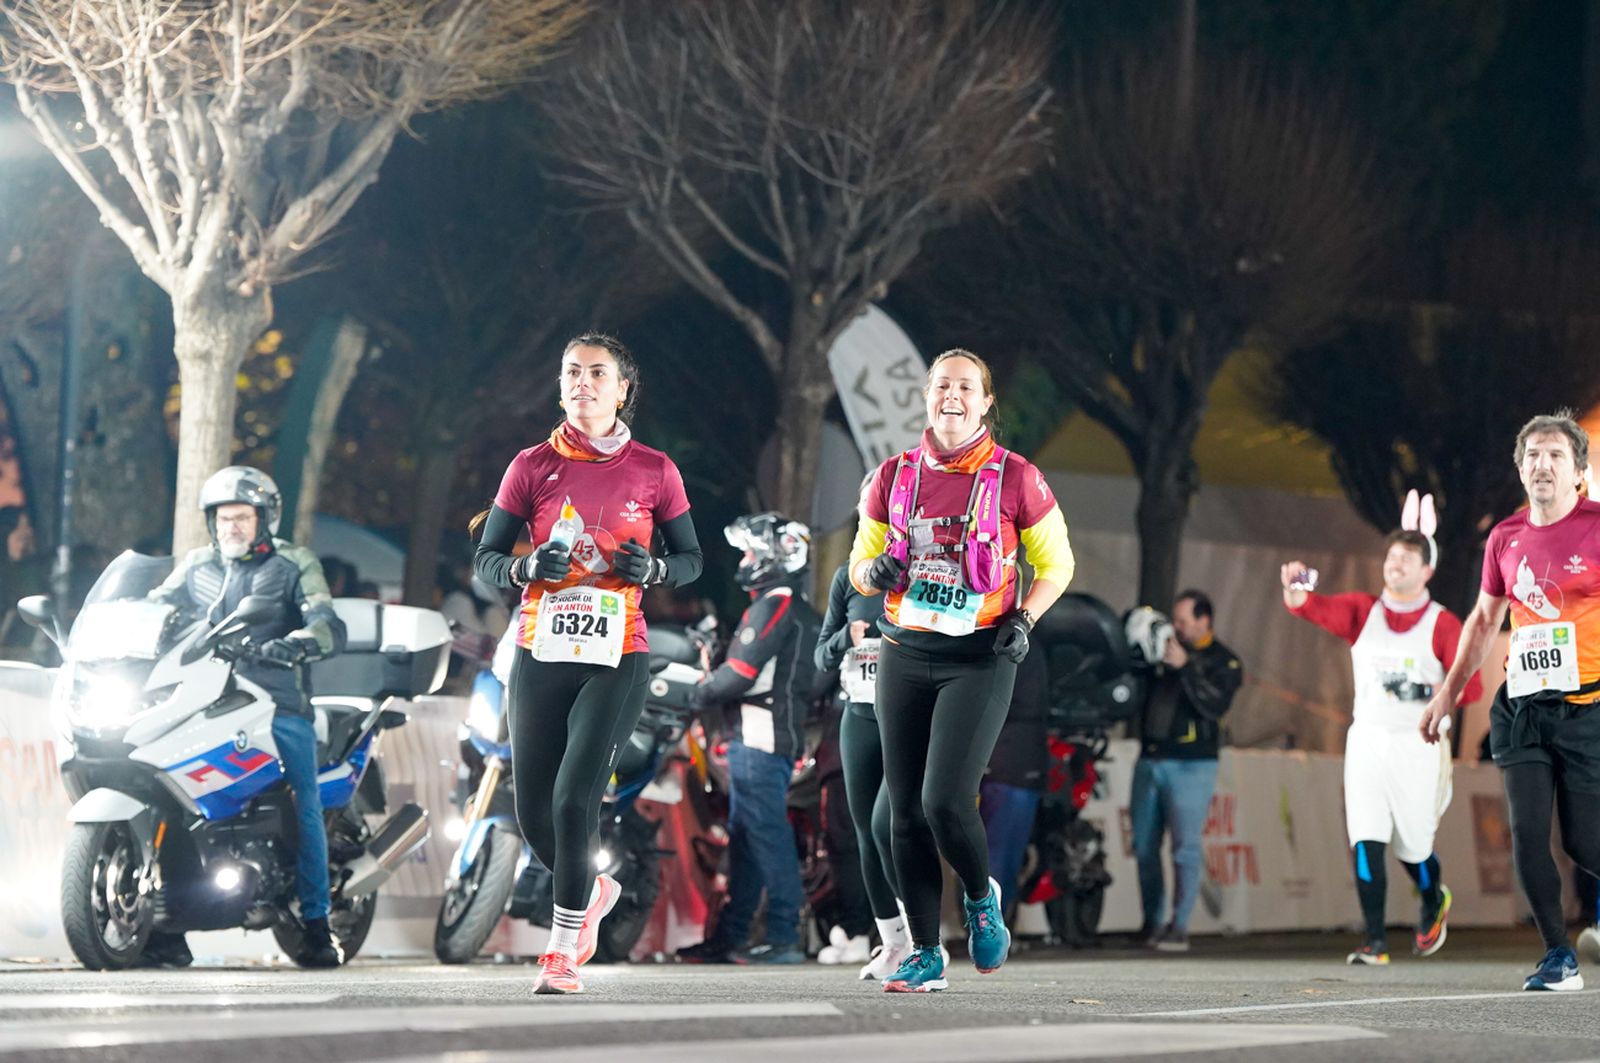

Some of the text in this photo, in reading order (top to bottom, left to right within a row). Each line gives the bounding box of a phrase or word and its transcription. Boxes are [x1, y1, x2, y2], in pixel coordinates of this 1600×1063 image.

[573, 540, 594, 561] 43
[930, 573, 957, 585] ANTON
[917, 581, 967, 610] 7859
[564, 603, 593, 612] ANTON
[551, 613, 608, 637] 6324
[1519, 648, 1562, 671] 1689
